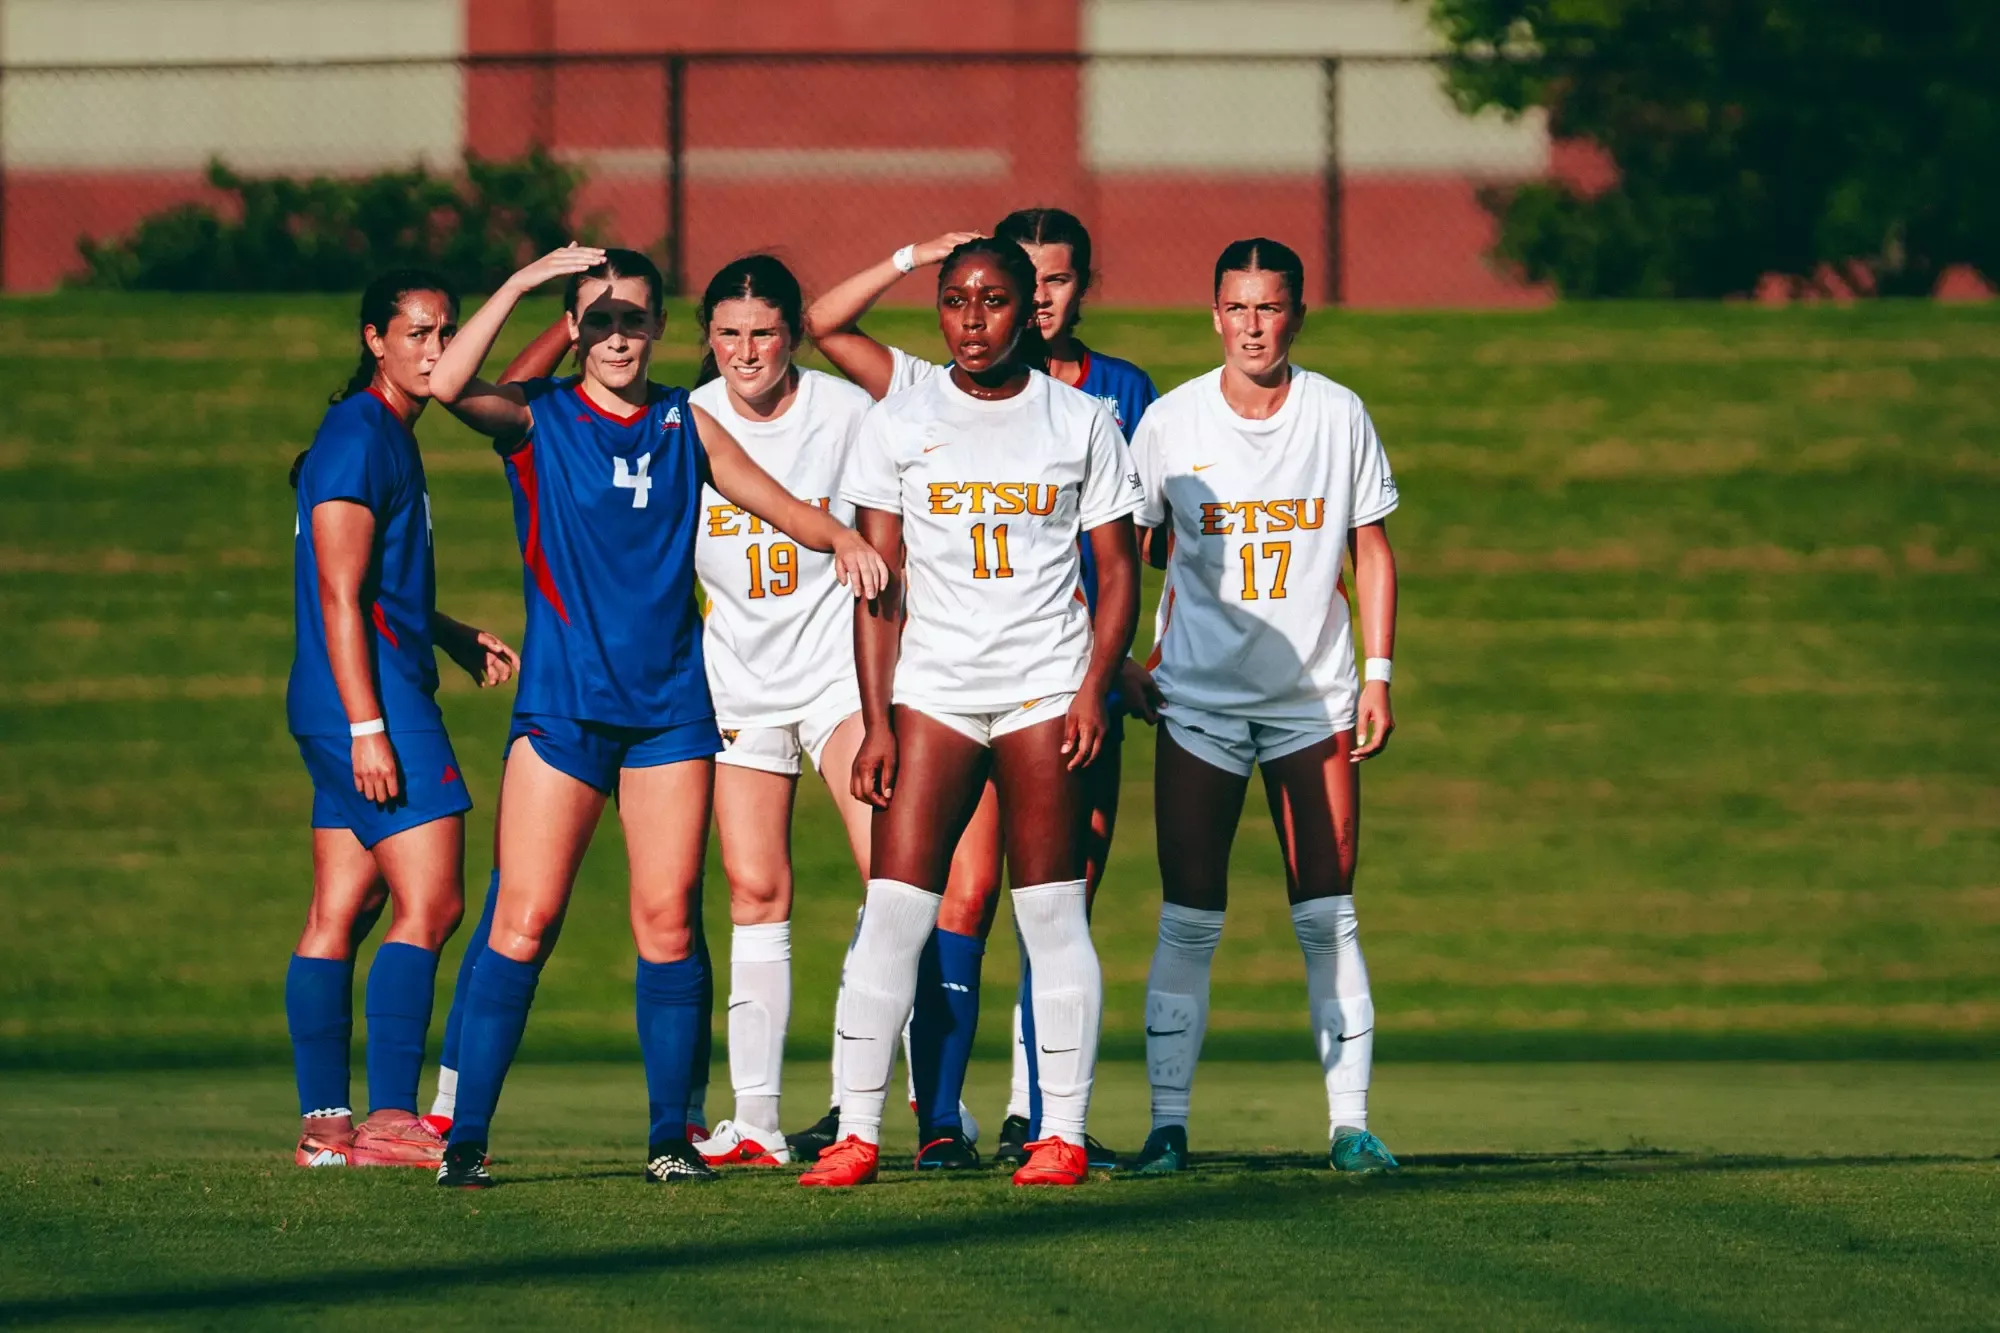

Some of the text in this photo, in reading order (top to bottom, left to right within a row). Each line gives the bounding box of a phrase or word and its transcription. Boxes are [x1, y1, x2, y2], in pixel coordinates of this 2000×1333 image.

[613, 452, 652, 508] 4
[927, 481, 1059, 516] ETSU
[1200, 498, 1325, 535] ETSU
[746, 542, 798, 599] 19
[971, 522, 1014, 579] 11
[1240, 540, 1291, 600] 17
